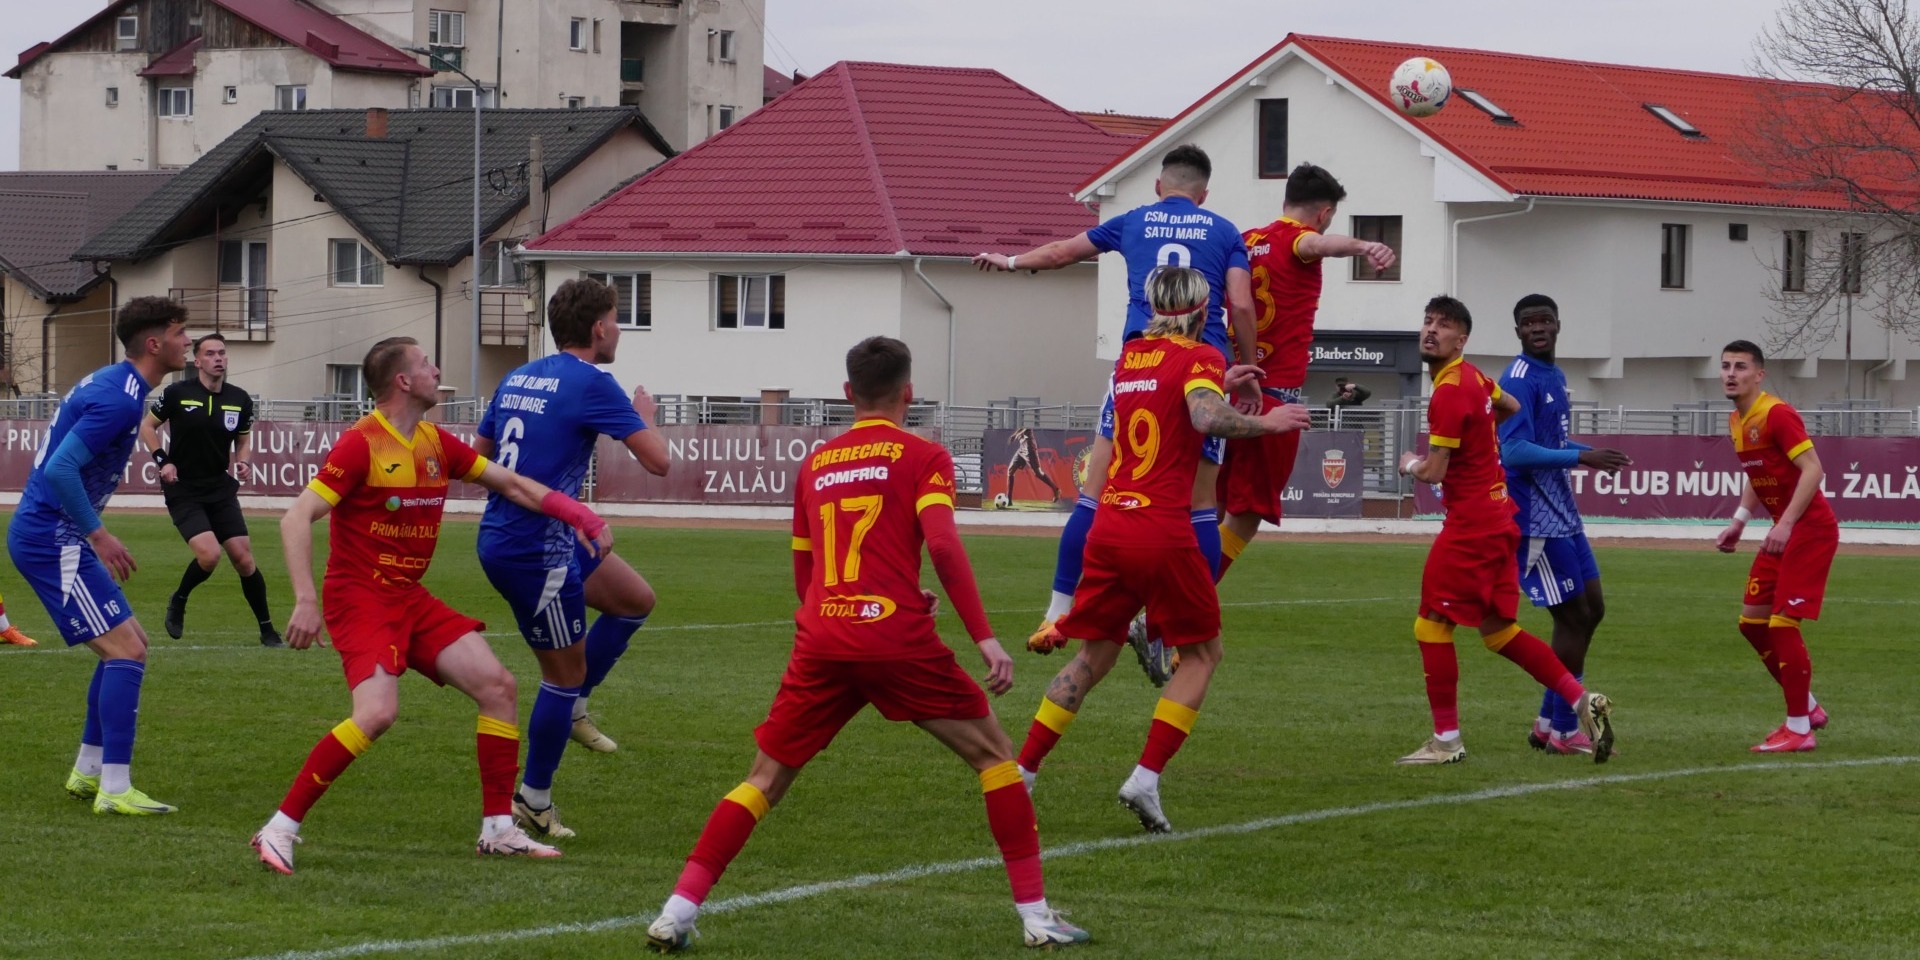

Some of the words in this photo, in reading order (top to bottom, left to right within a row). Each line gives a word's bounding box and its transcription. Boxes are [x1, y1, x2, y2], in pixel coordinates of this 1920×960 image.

[1400, 85, 1423, 102] Joma
[1144, 211, 1168, 223] CSM
[1169, 214, 1213, 226] OLIMPIA
[1144, 226, 1173, 238] SATU
[1175, 227, 1208, 240] MARE
[1247, 243, 1270, 261] FRIG
[1315, 346, 1353, 360] Barber
[1354, 347, 1384, 364] Shop
[506, 374, 527, 388] CSM
[524, 376, 560, 393] OLIMPIA
[1115, 378, 1157, 395] COMFRIG
[500, 394, 521, 409] SATU
[519, 396, 548, 414] MARE
[8, 429, 39, 451] PRI
[497, 416, 525, 473] 6
[628, 438, 765, 462] NSILIUL
[811, 442, 904, 471] CHERECHEȘ
[325, 462, 345, 478] Avril
[815, 466, 888, 491] COMFRIG
[704, 465, 786, 494] ZALĂU
[1594, 470, 1669, 495] CLUB
[1842, 466, 1920, 499] ZALĂ
[1280, 486, 1303, 501] LĂU
[820, 494, 883, 587] 17
[379, 553, 430, 569] SILCO
[1562, 578, 1575, 593] 19
[103, 600, 121, 617] 16
[820, 603, 858, 617] TOTAL
[861, 603, 880, 617] AS
[573, 619, 582, 634] 6
